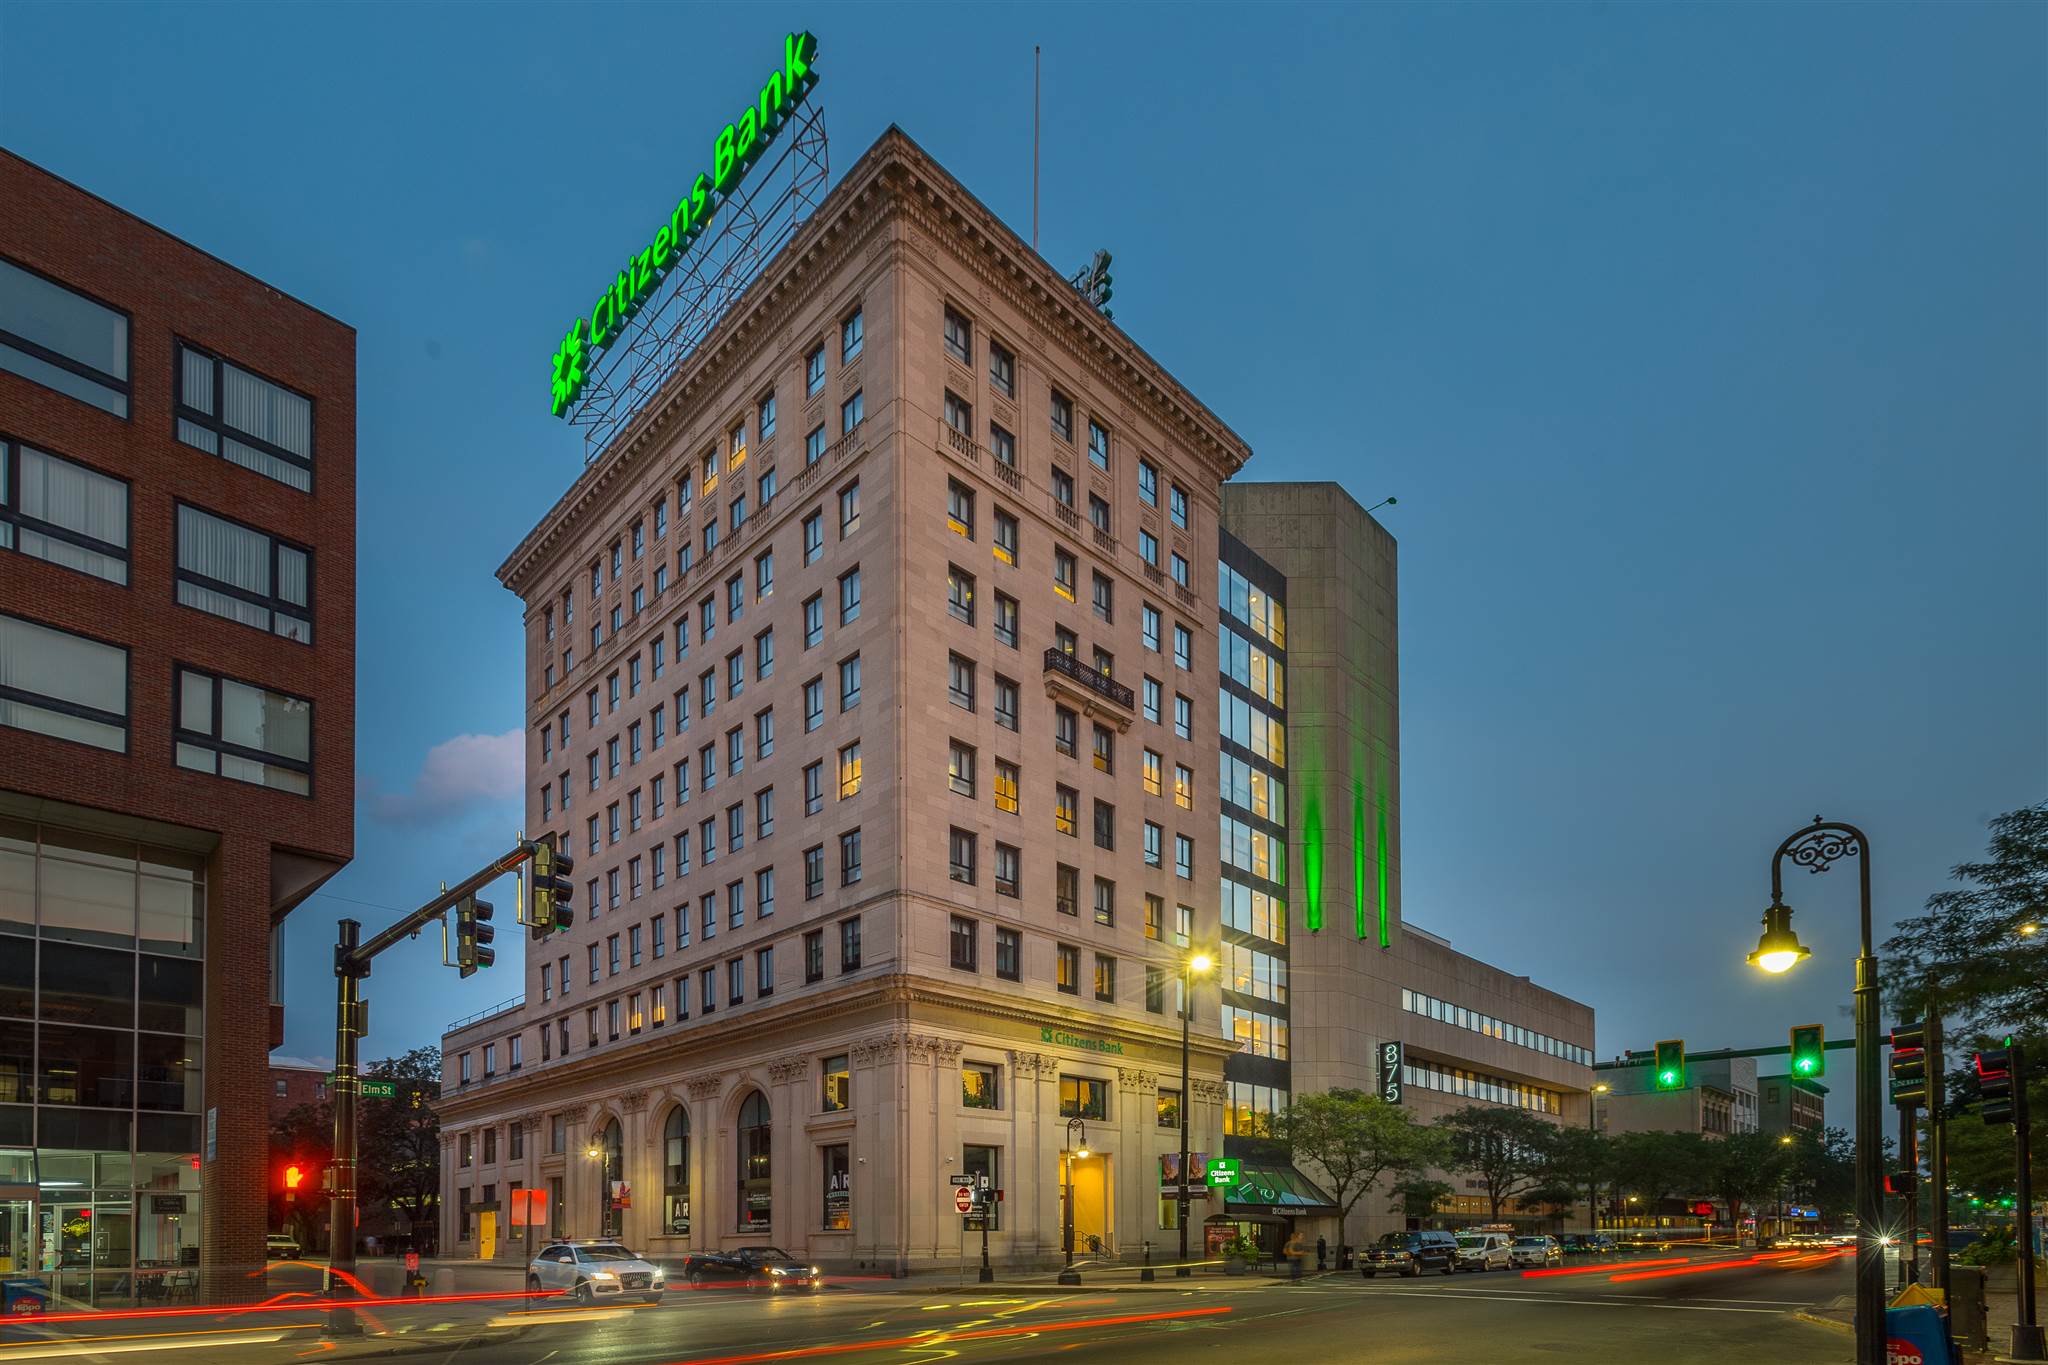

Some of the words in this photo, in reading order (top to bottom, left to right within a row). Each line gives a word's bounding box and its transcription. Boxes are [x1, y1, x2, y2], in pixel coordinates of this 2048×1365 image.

[591, 172, 713, 348] Citizens
[713, 31, 819, 195] Bank
[1055, 1031, 1097, 1051] Citizens
[1099, 1039, 1123, 1056] Bank
[1385, 1044, 1398, 1102] 875
[362, 1084, 380, 1094] Elm
[381, 1085, 392, 1095] St
[1210, 1170, 1235, 1178] Citizens
[1214, 1176, 1231, 1184] Bank
[1277, 1207, 1296, 1215] Citizens
[1887, 1352, 1922, 1365] ppo
